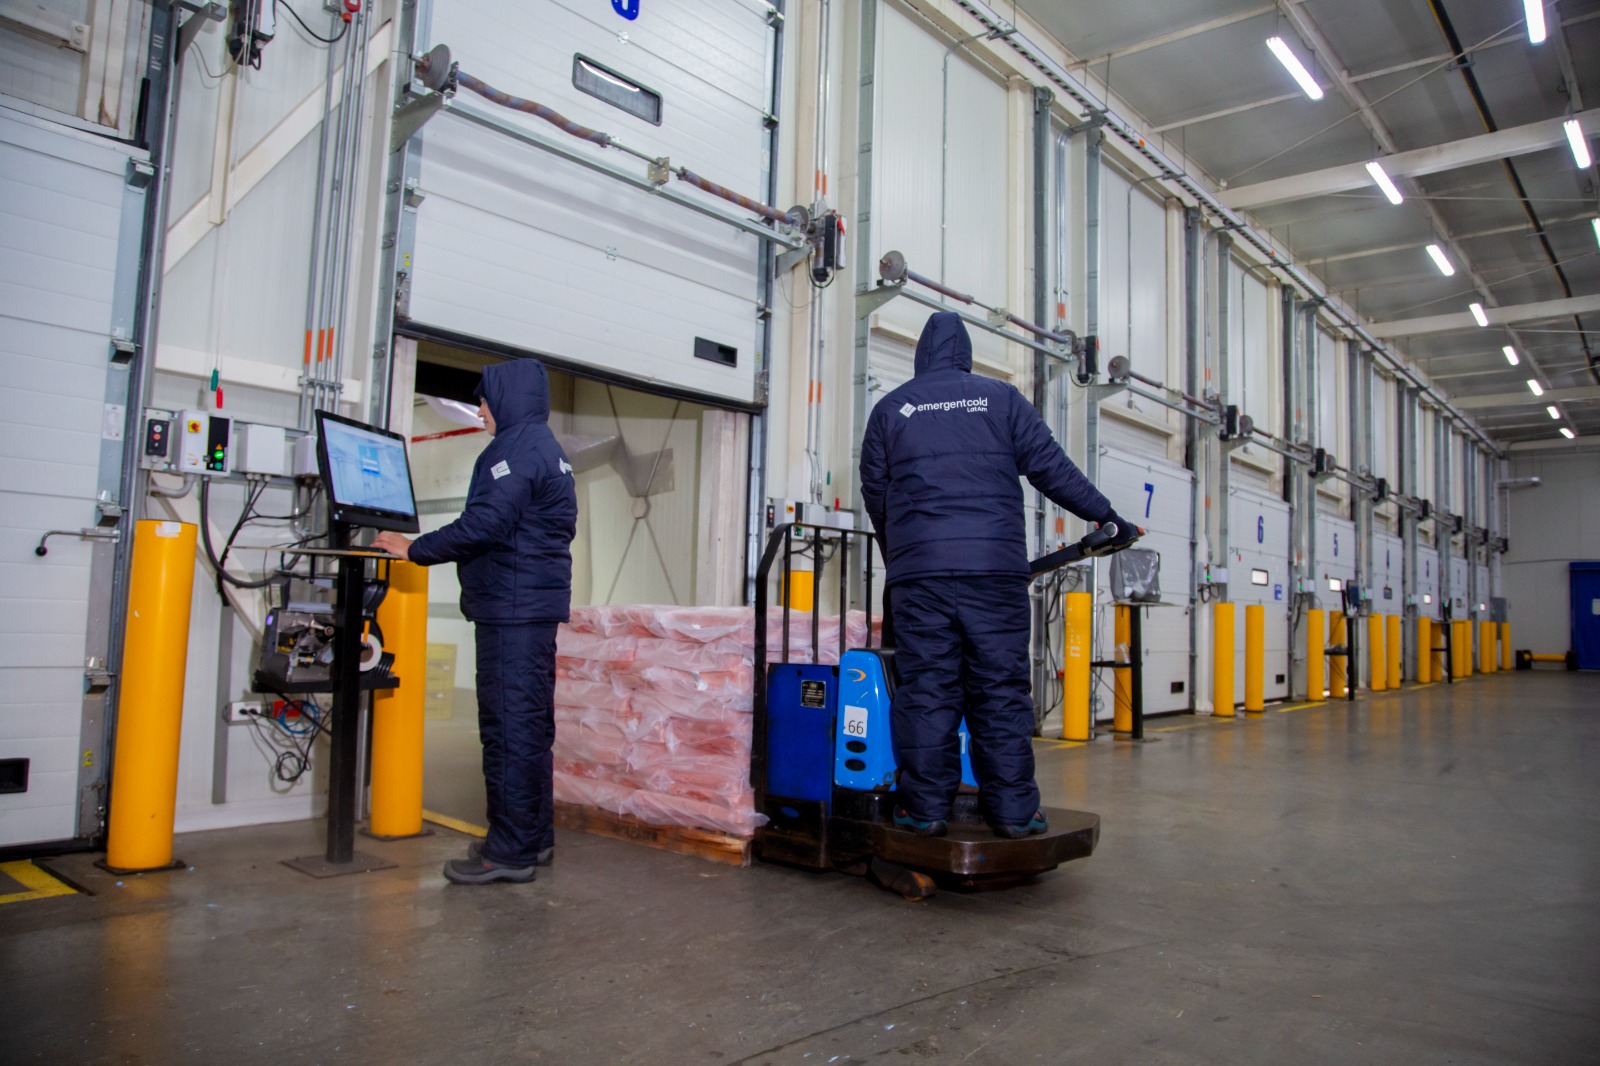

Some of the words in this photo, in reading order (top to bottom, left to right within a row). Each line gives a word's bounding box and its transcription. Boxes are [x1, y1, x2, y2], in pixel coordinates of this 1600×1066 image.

[1144, 482, 1154, 518] 7
[1257, 515, 1264, 544] 6
[1333, 532, 1338, 557] 5
[848, 719, 864, 735] 66
